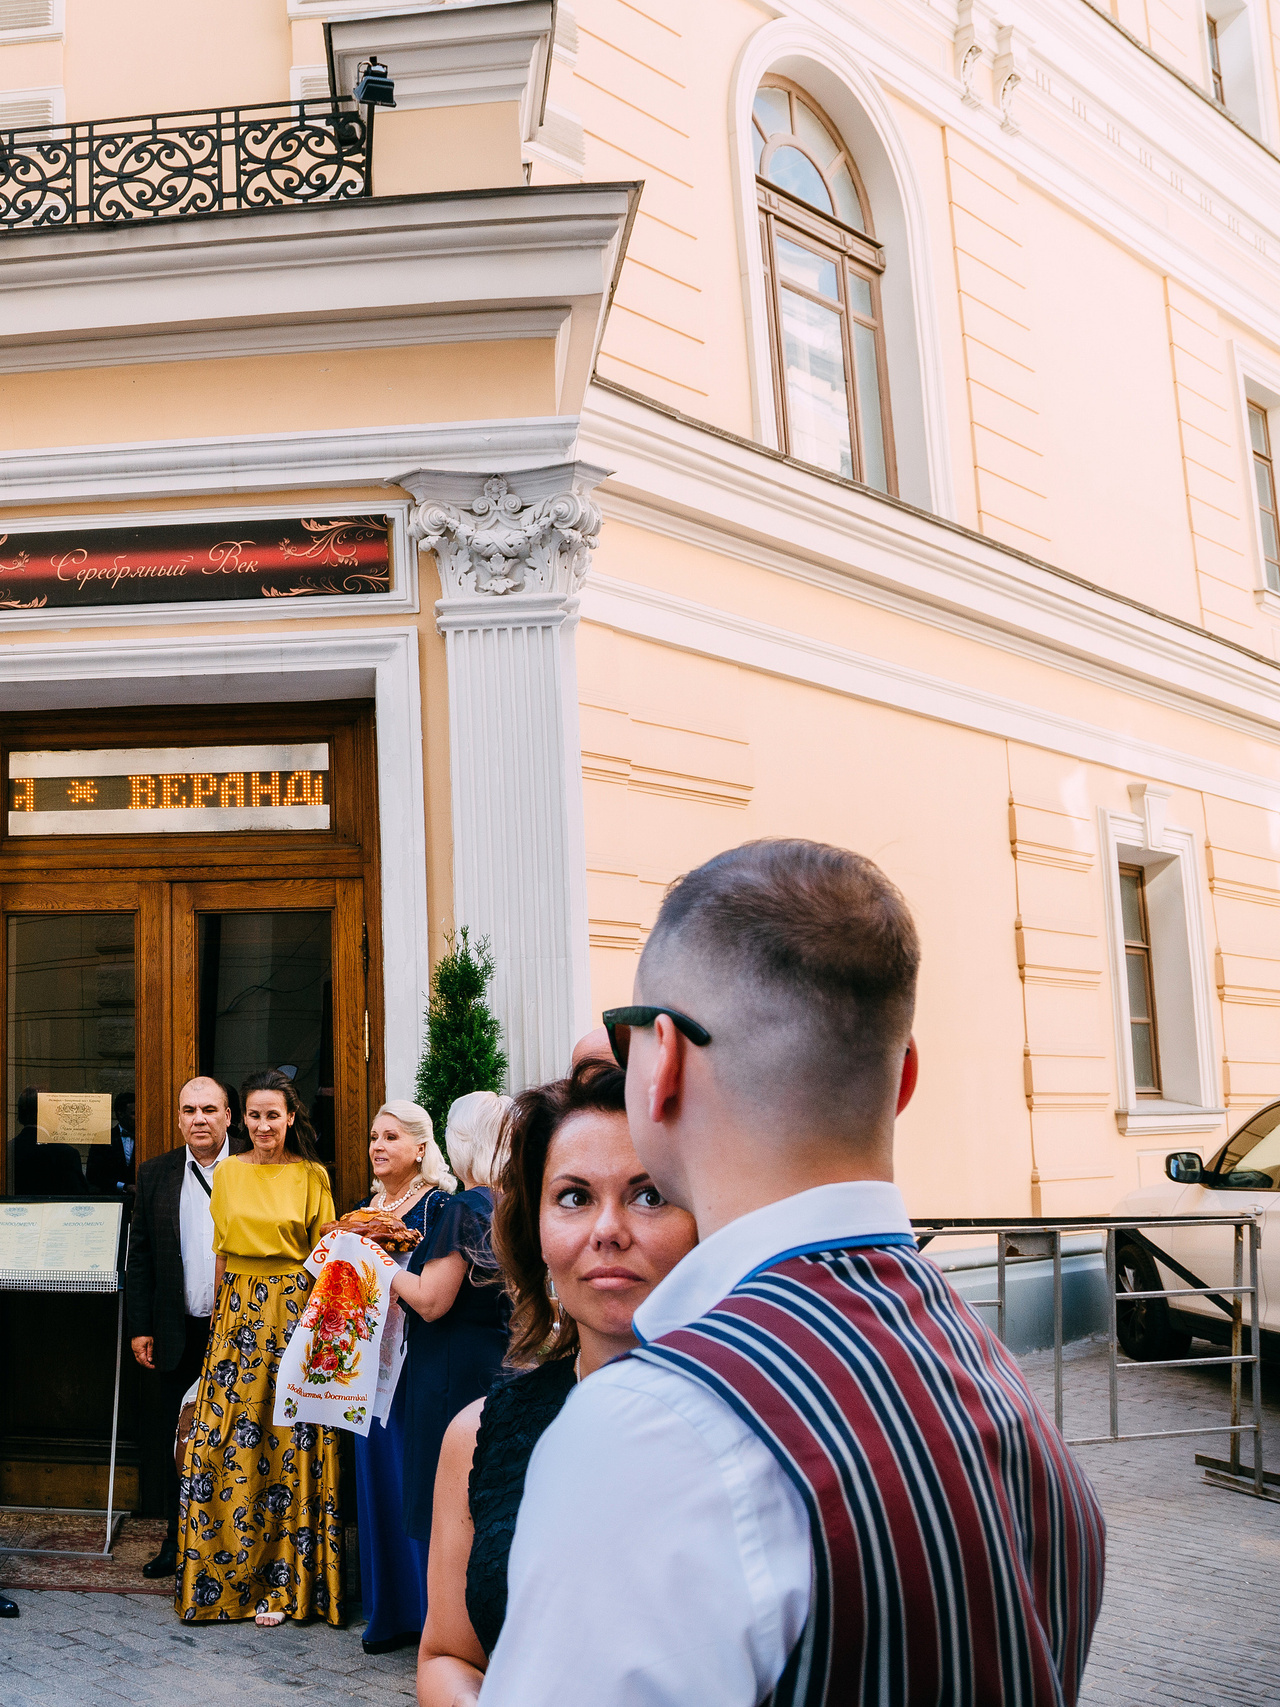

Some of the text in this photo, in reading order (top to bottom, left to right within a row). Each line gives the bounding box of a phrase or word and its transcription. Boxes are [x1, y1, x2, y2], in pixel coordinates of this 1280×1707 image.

[50, 540, 259, 591] Серебряный Век
[127, 769, 324, 810] ВЕРАНД
